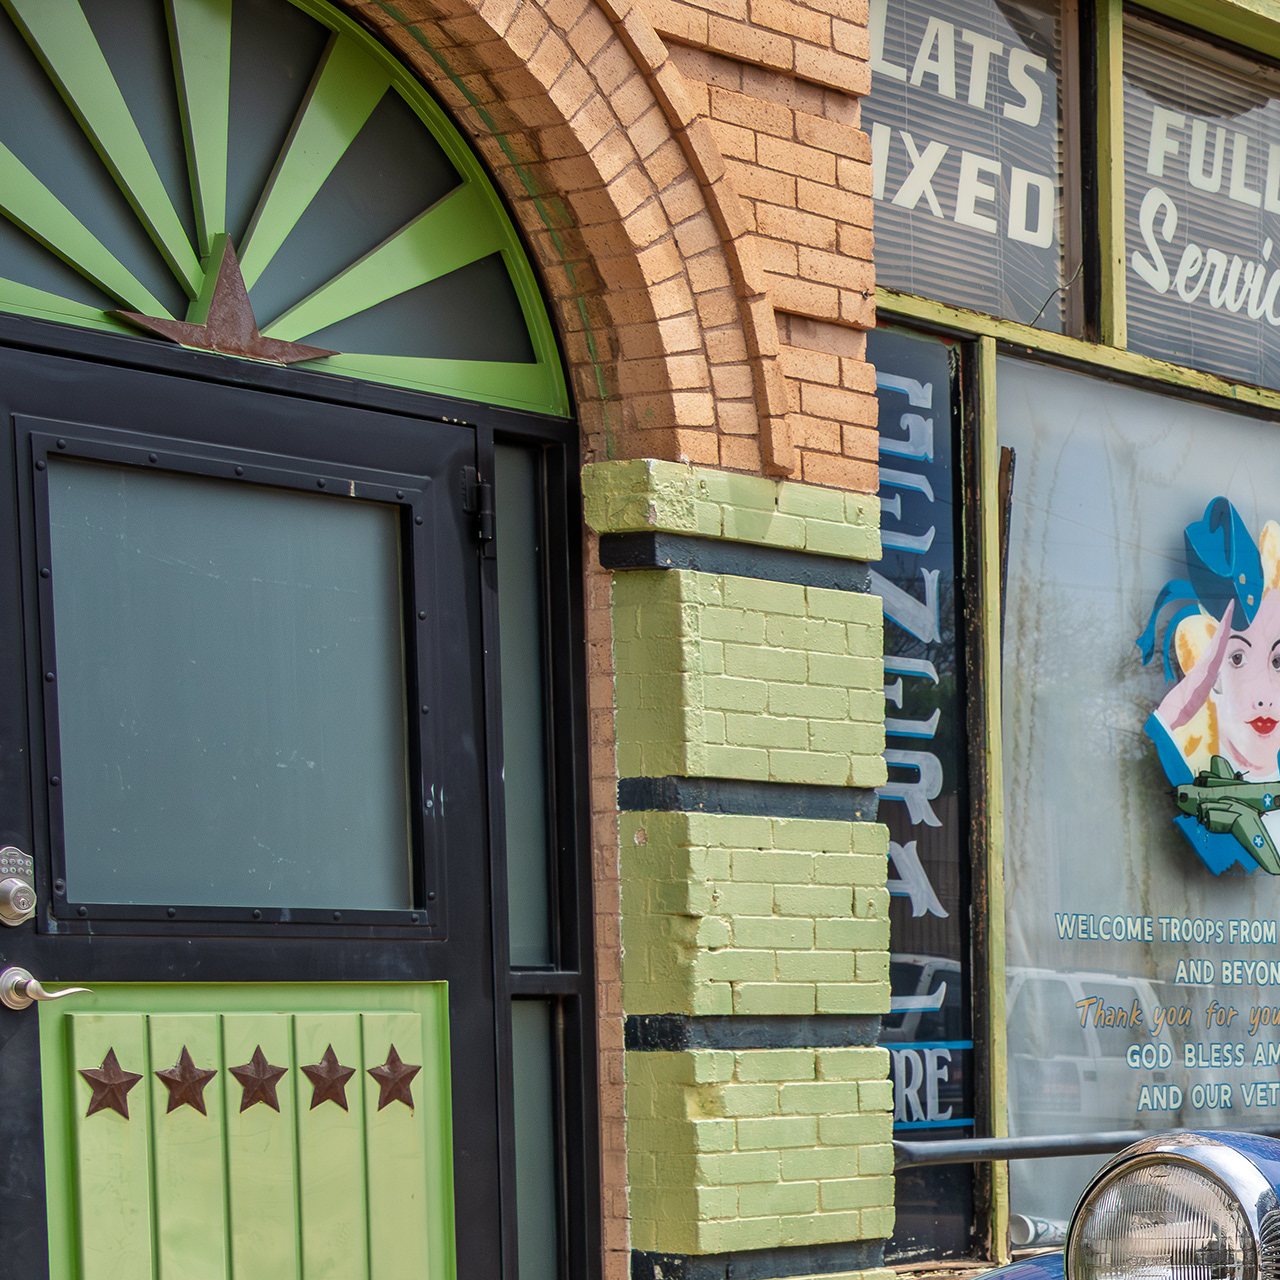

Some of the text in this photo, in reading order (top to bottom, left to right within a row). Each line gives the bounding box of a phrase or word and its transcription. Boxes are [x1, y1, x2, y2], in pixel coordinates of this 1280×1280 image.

[868, 0, 1047, 127] LATS
[871, 122, 1055, 249] IXED
[1055, 913, 1153, 942] WELCOME
[1158, 916, 1224, 944] TROOPS
[1228, 919, 1276, 945] FROM
[1174, 959, 1215, 985] AND
[1075, 996, 1143, 1028] Thank
[1150, 1005, 1192, 1036] you
[1205, 1000, 1238, 1029] for
[1126, 1043, 1173, 1069] GOD
[1184, 1042, 1245, 1068] BLESS
[888, 1047, 953, 1123] RE
[1137, 1085, 1183, 1111] AND
[1191, 1083, 1232, 1109] OUR
